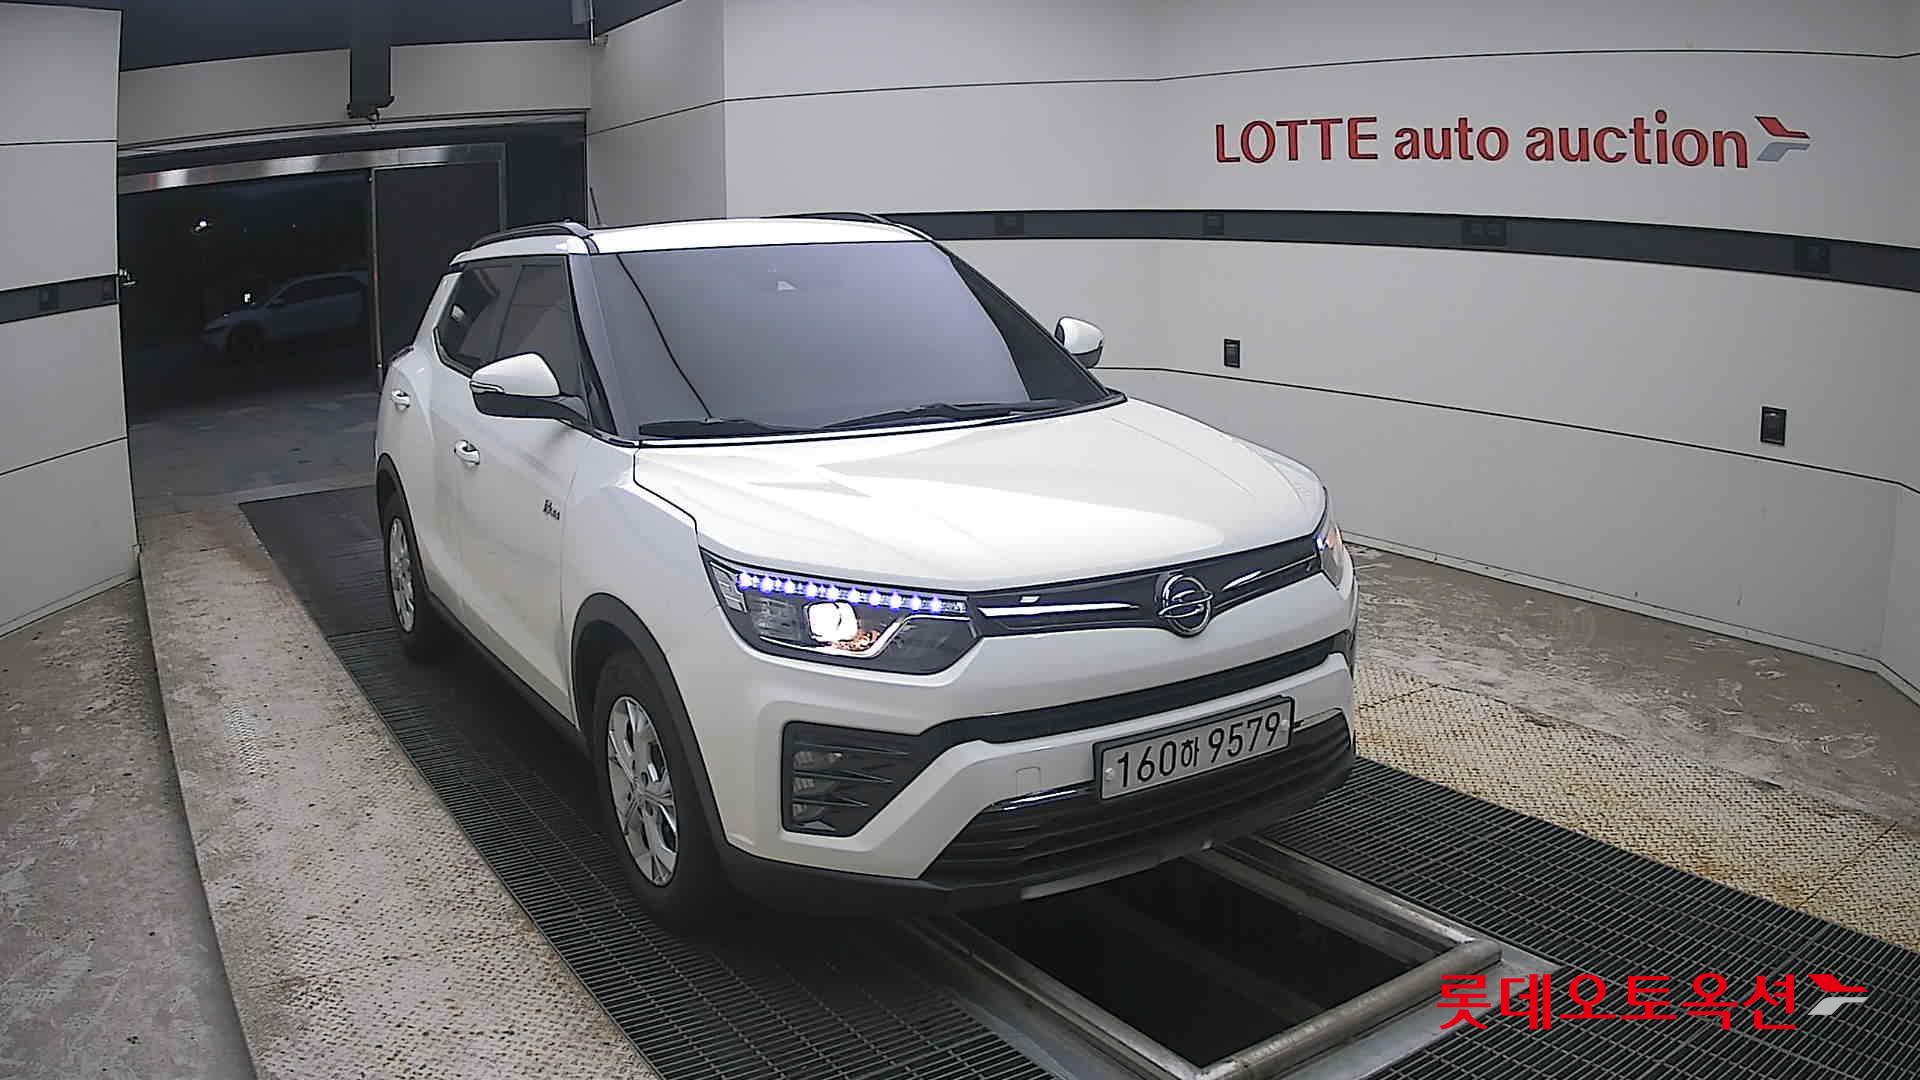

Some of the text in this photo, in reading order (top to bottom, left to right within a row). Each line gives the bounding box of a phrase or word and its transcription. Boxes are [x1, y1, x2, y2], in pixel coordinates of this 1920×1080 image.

[1215, 109, 1749, 169] LOTTE auto auction
[1117, 711, 1281, 788] 160하 9579
